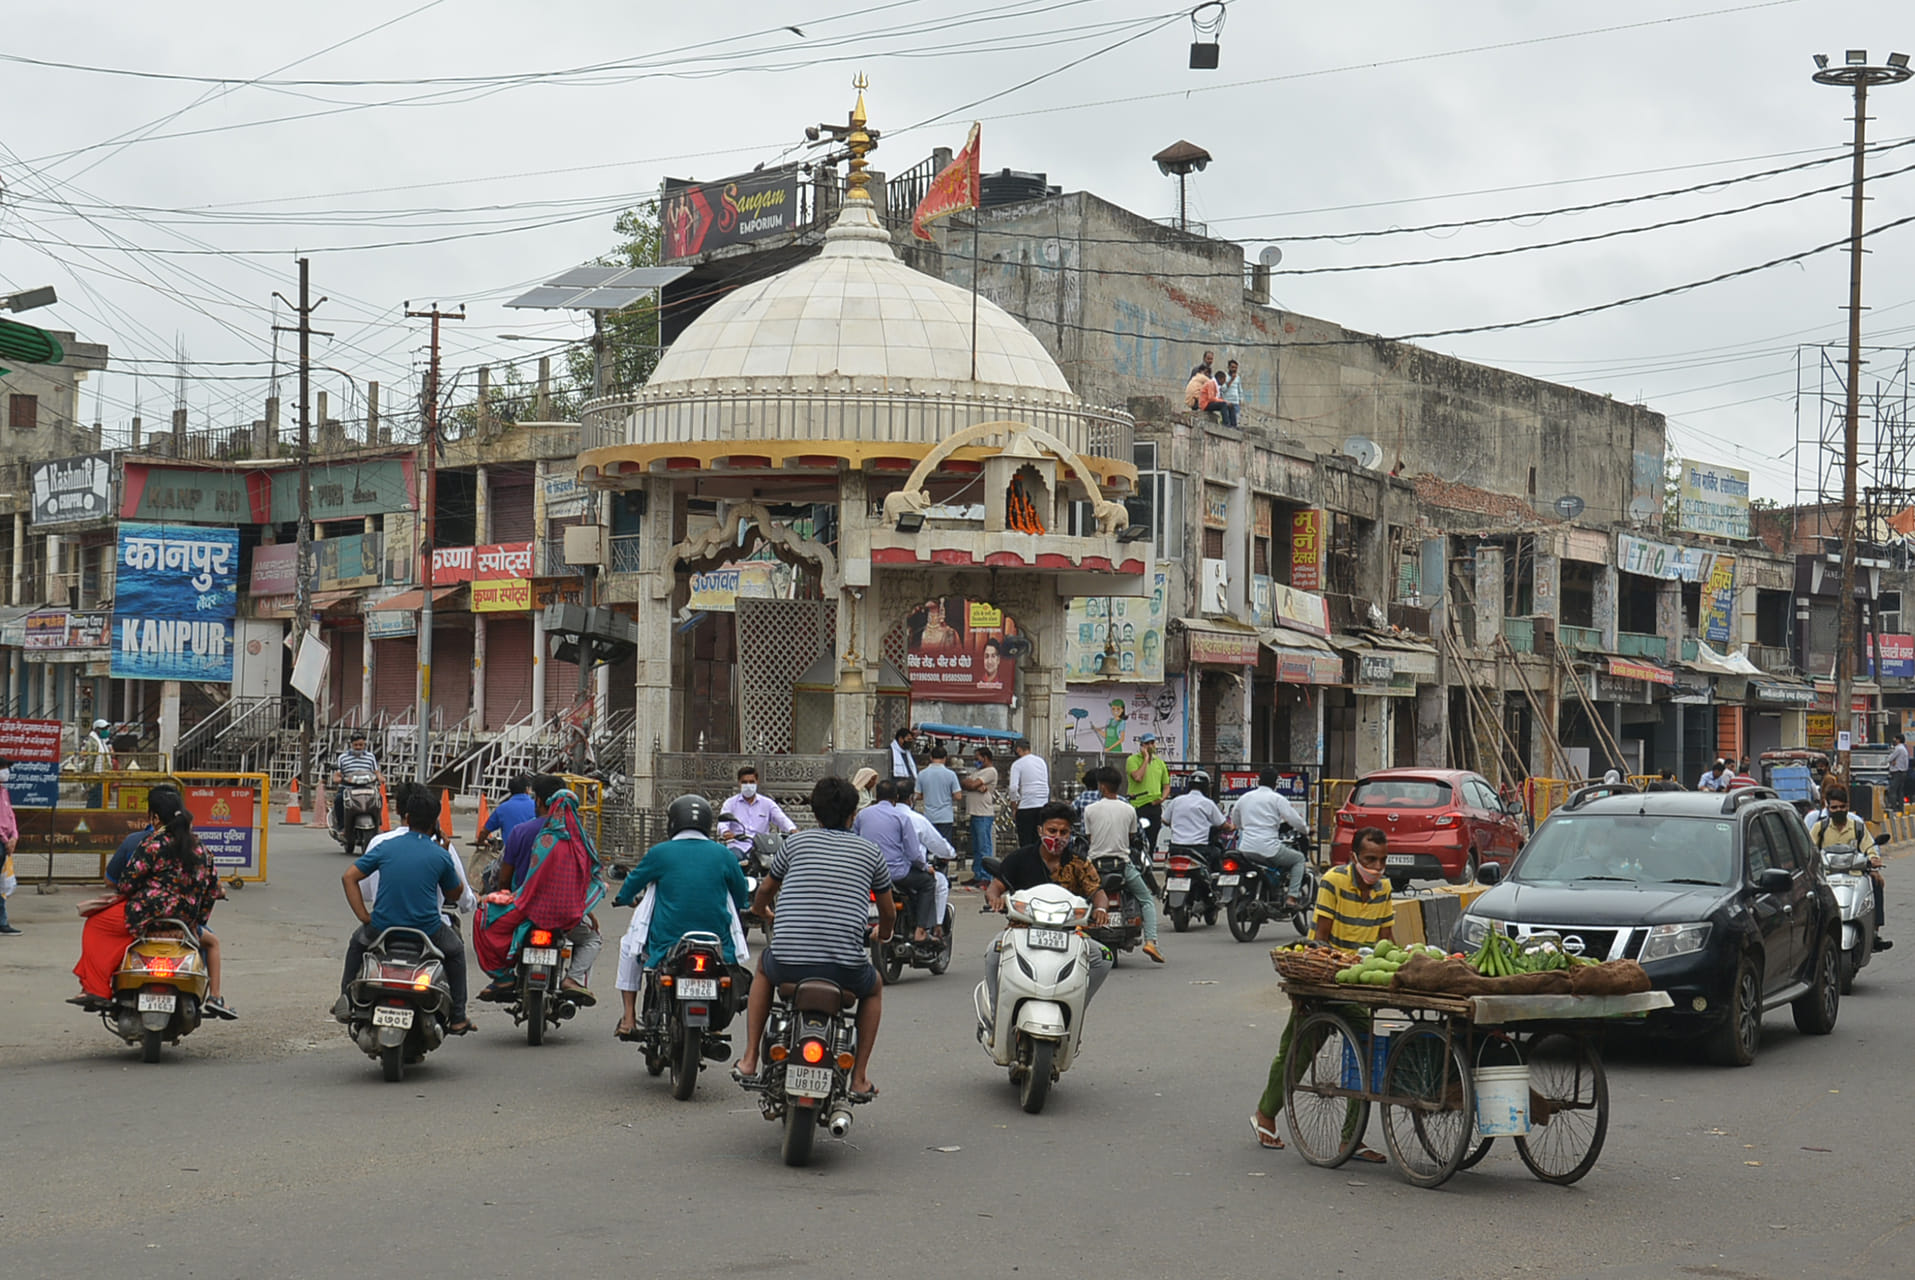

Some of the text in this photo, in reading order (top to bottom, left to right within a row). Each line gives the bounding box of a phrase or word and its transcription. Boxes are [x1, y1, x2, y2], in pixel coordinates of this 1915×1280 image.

[718, 183, 786, 232] Sangam
[740, 214, 783, 234] EMPORIUM
[125, 537, 233, 592] कानपुर
[1704, 564, 1733, 593] ुलिस
[122, 618, 225, 655] KANPUR
[1275, 775, 1292, 791] लिस
[231, 790, 251, 798] STOP
[797, 1067, 828, 1081] UP11A
[795, 1078, 828, 1091] U8107
